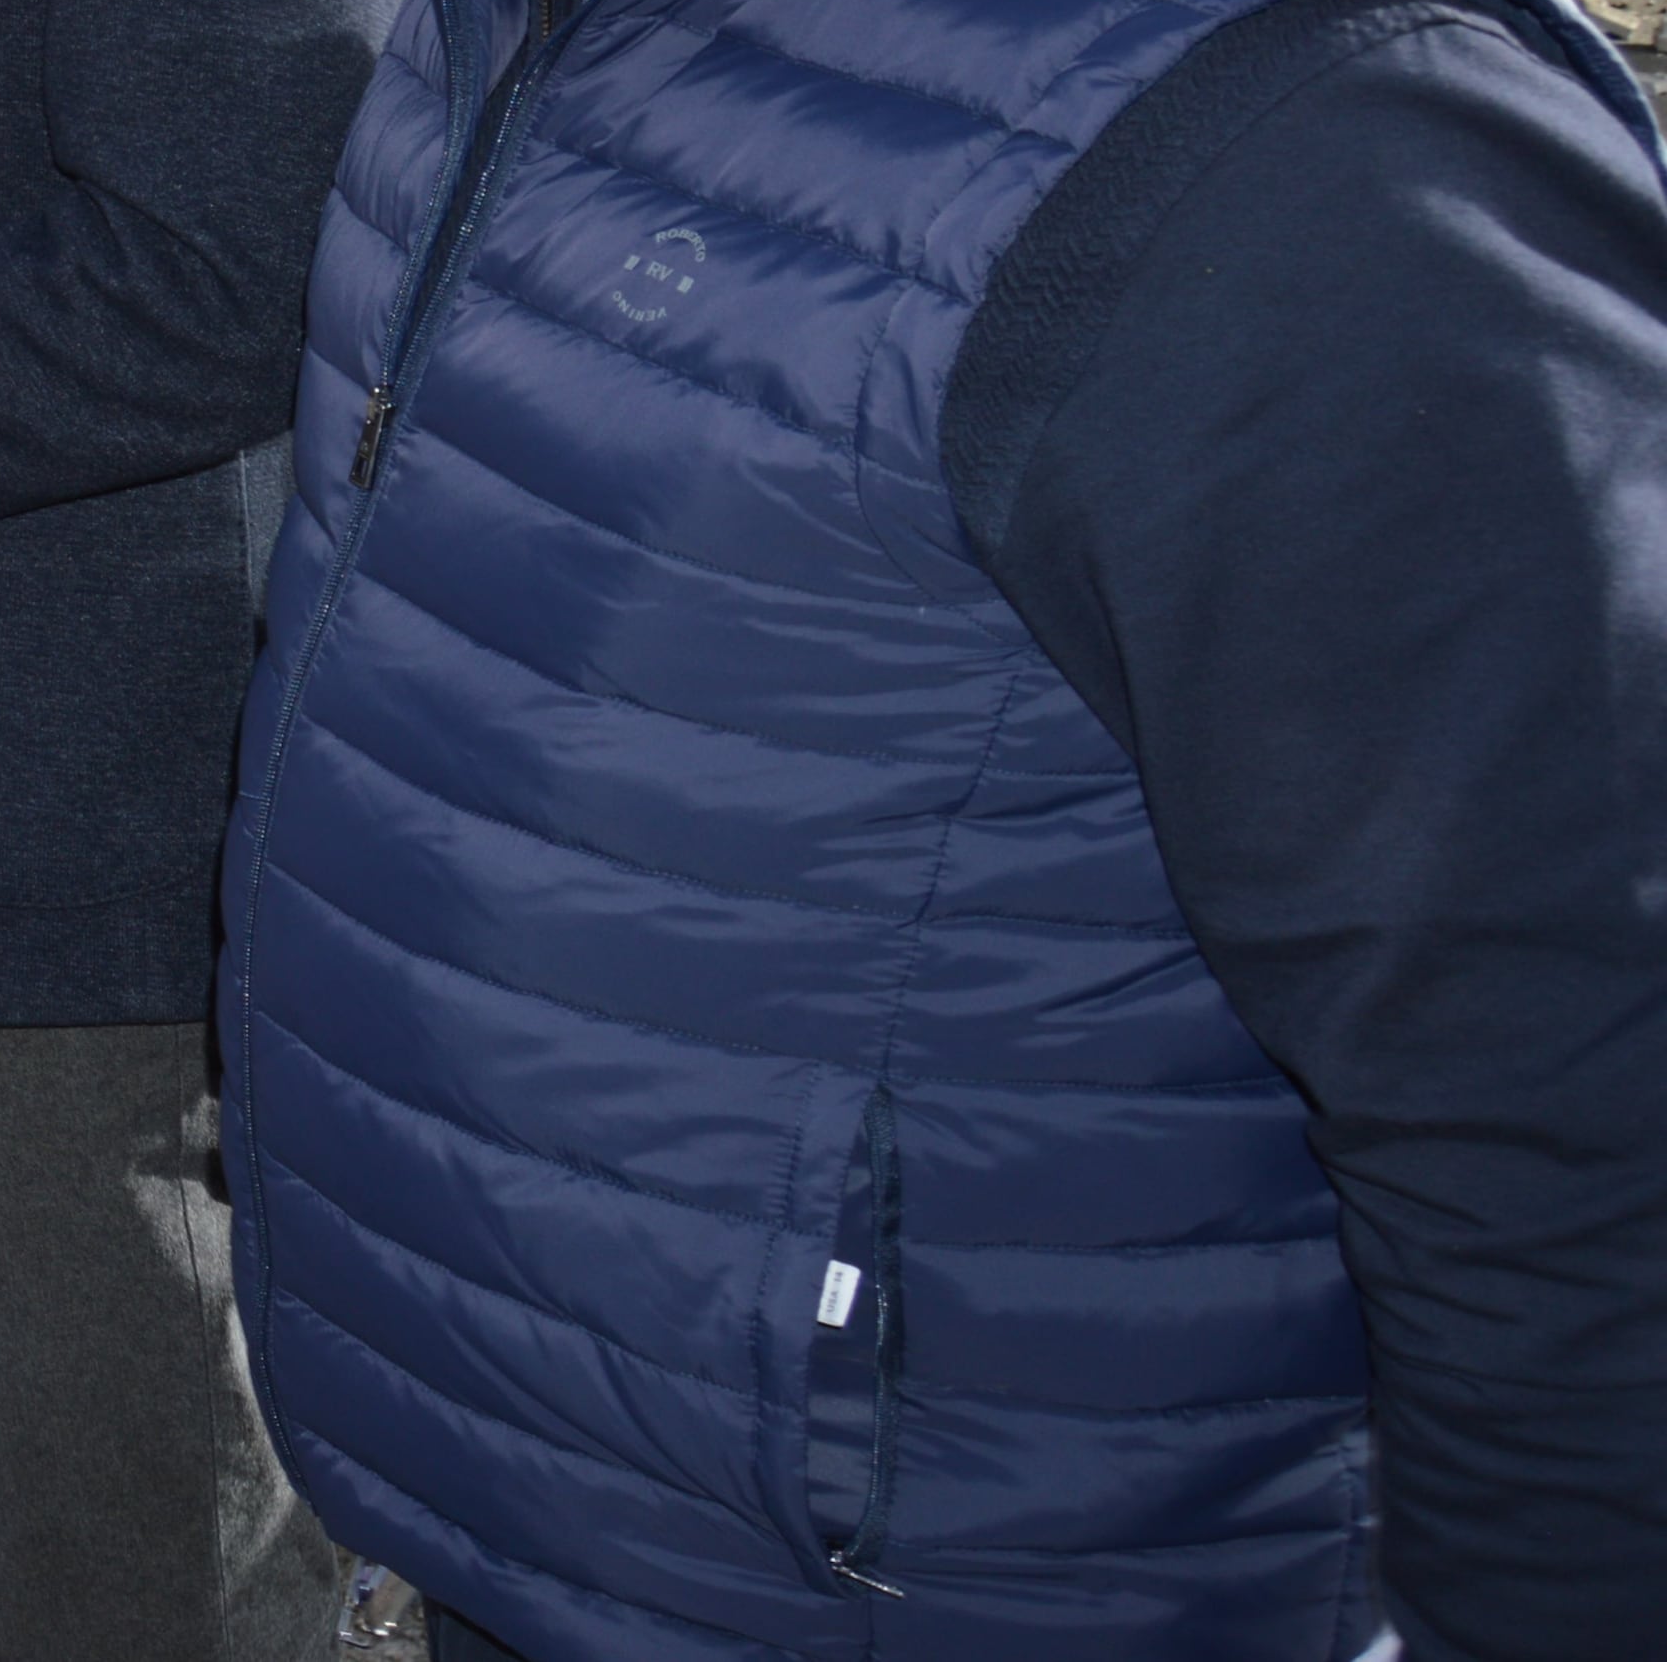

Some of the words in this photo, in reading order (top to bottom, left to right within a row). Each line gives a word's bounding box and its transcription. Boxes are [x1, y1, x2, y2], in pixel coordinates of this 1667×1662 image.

[655, 228, 706, 262] ROBERTO
[645, 260, 674, 281] RV
[612, 290, 667, 322] VERINO
